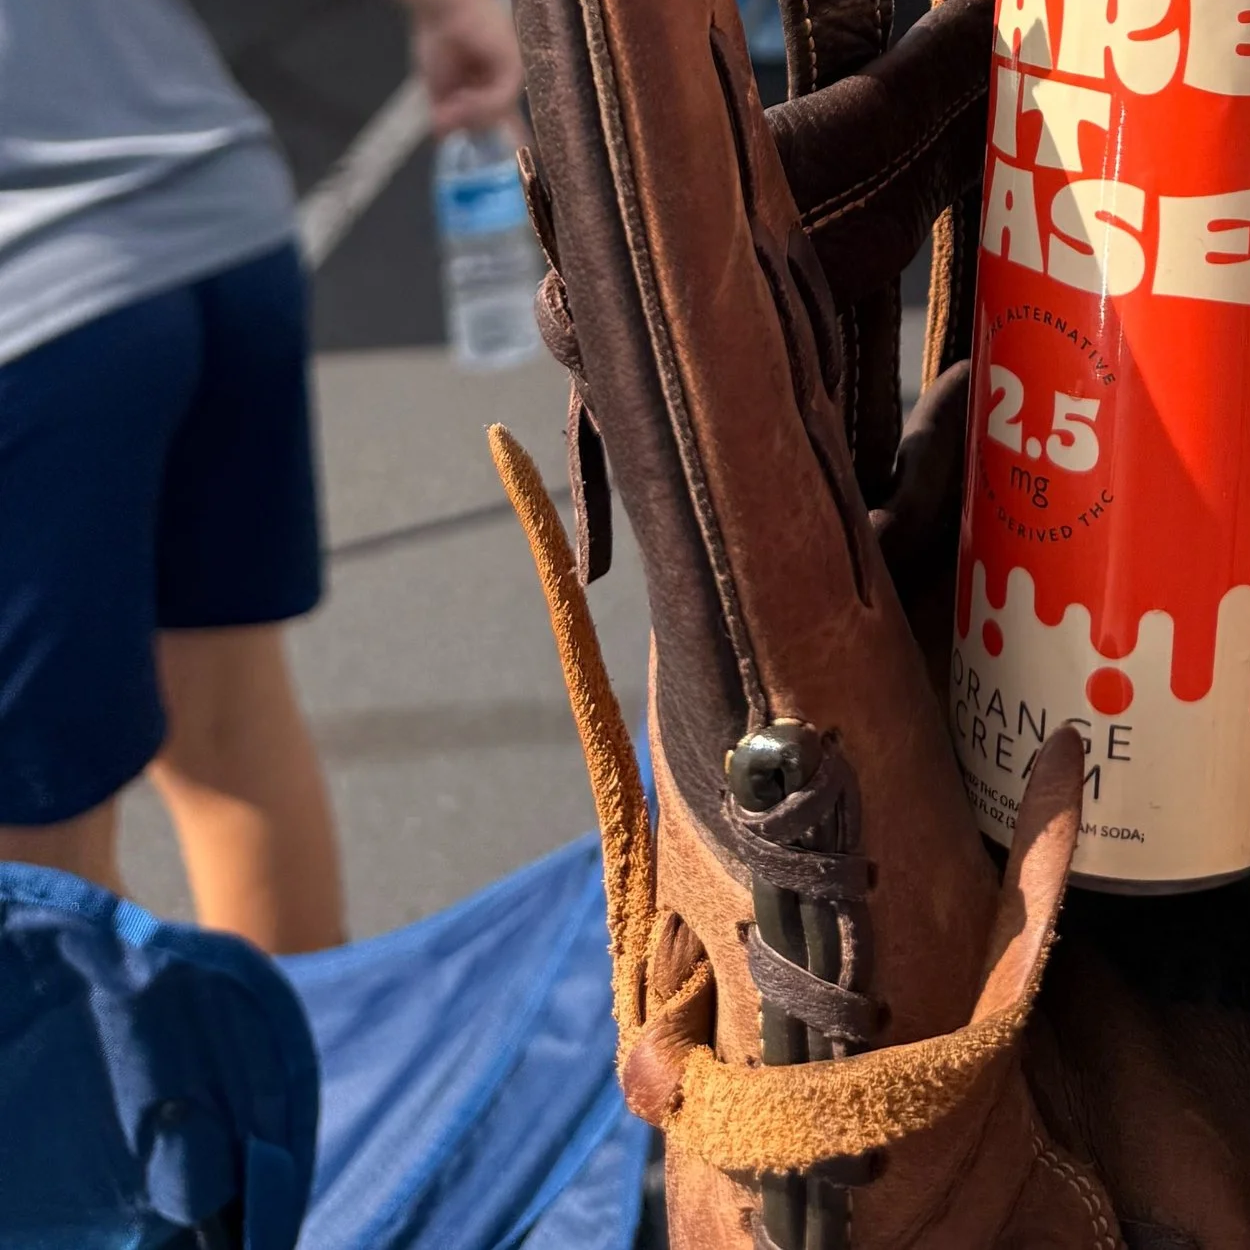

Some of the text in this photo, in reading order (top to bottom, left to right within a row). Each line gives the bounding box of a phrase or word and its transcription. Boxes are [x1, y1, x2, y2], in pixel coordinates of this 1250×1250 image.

[992, 65, 1112, 173] IT
[1007, 305, 1116, 386] ALTERNATIVE
[987, 363, 1101, 473] 2.5
[997, 488, 1115, 543] DERIVED THC
[1010, 466, 1050, 509] mg
[980, 780, 999, 802] THC
[1100, 825, 1145, 844] SODA;
